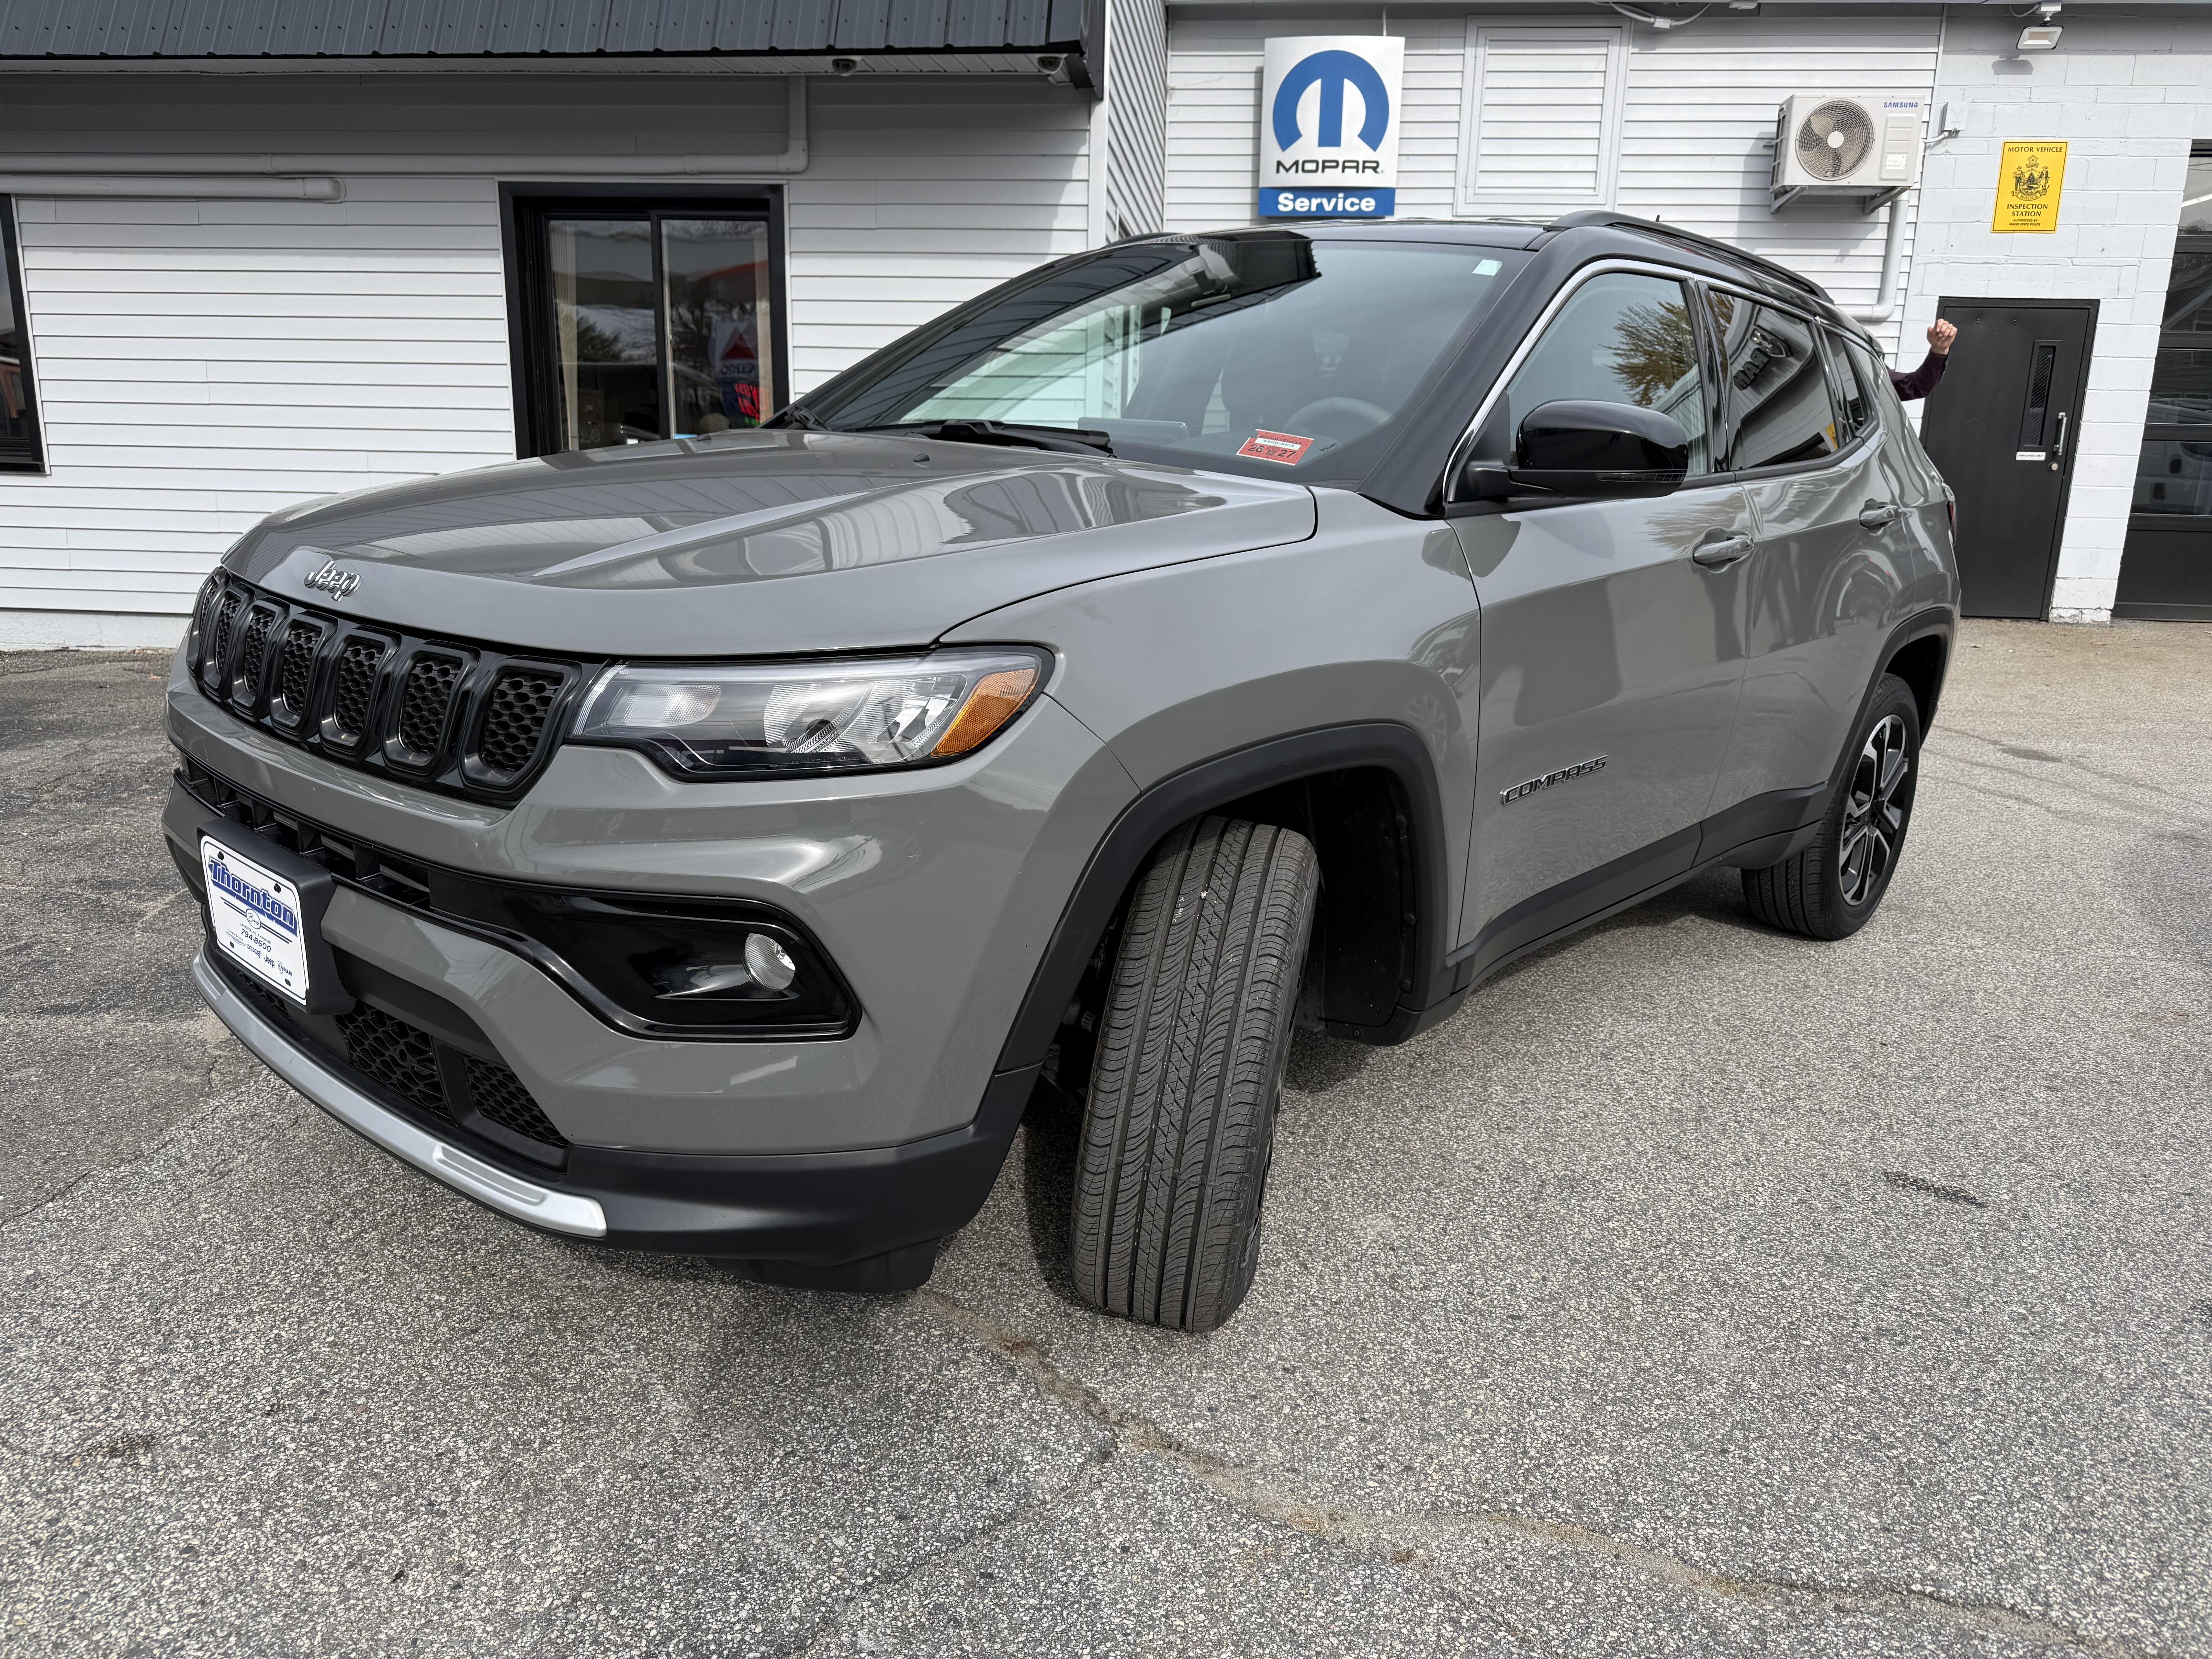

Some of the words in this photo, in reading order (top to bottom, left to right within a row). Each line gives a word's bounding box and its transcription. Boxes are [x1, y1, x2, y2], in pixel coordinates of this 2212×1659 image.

[1276, 159, 1380, 174] MOPAR
[1278, 193, 1376, 212] Service
[1248, 445, 1264, 453] 26
[1278, 449, 1296, 458] 27
[304, 560, 362, 602] Jeep
[1499, 755, 1608, 805] COMPASS
[210, 856, 297, 931] Thornton
[241, 928, 271, 952] 794-8600
[264, 954, 275, 968] Jeep
[283, 968, 292, 976] RAM
